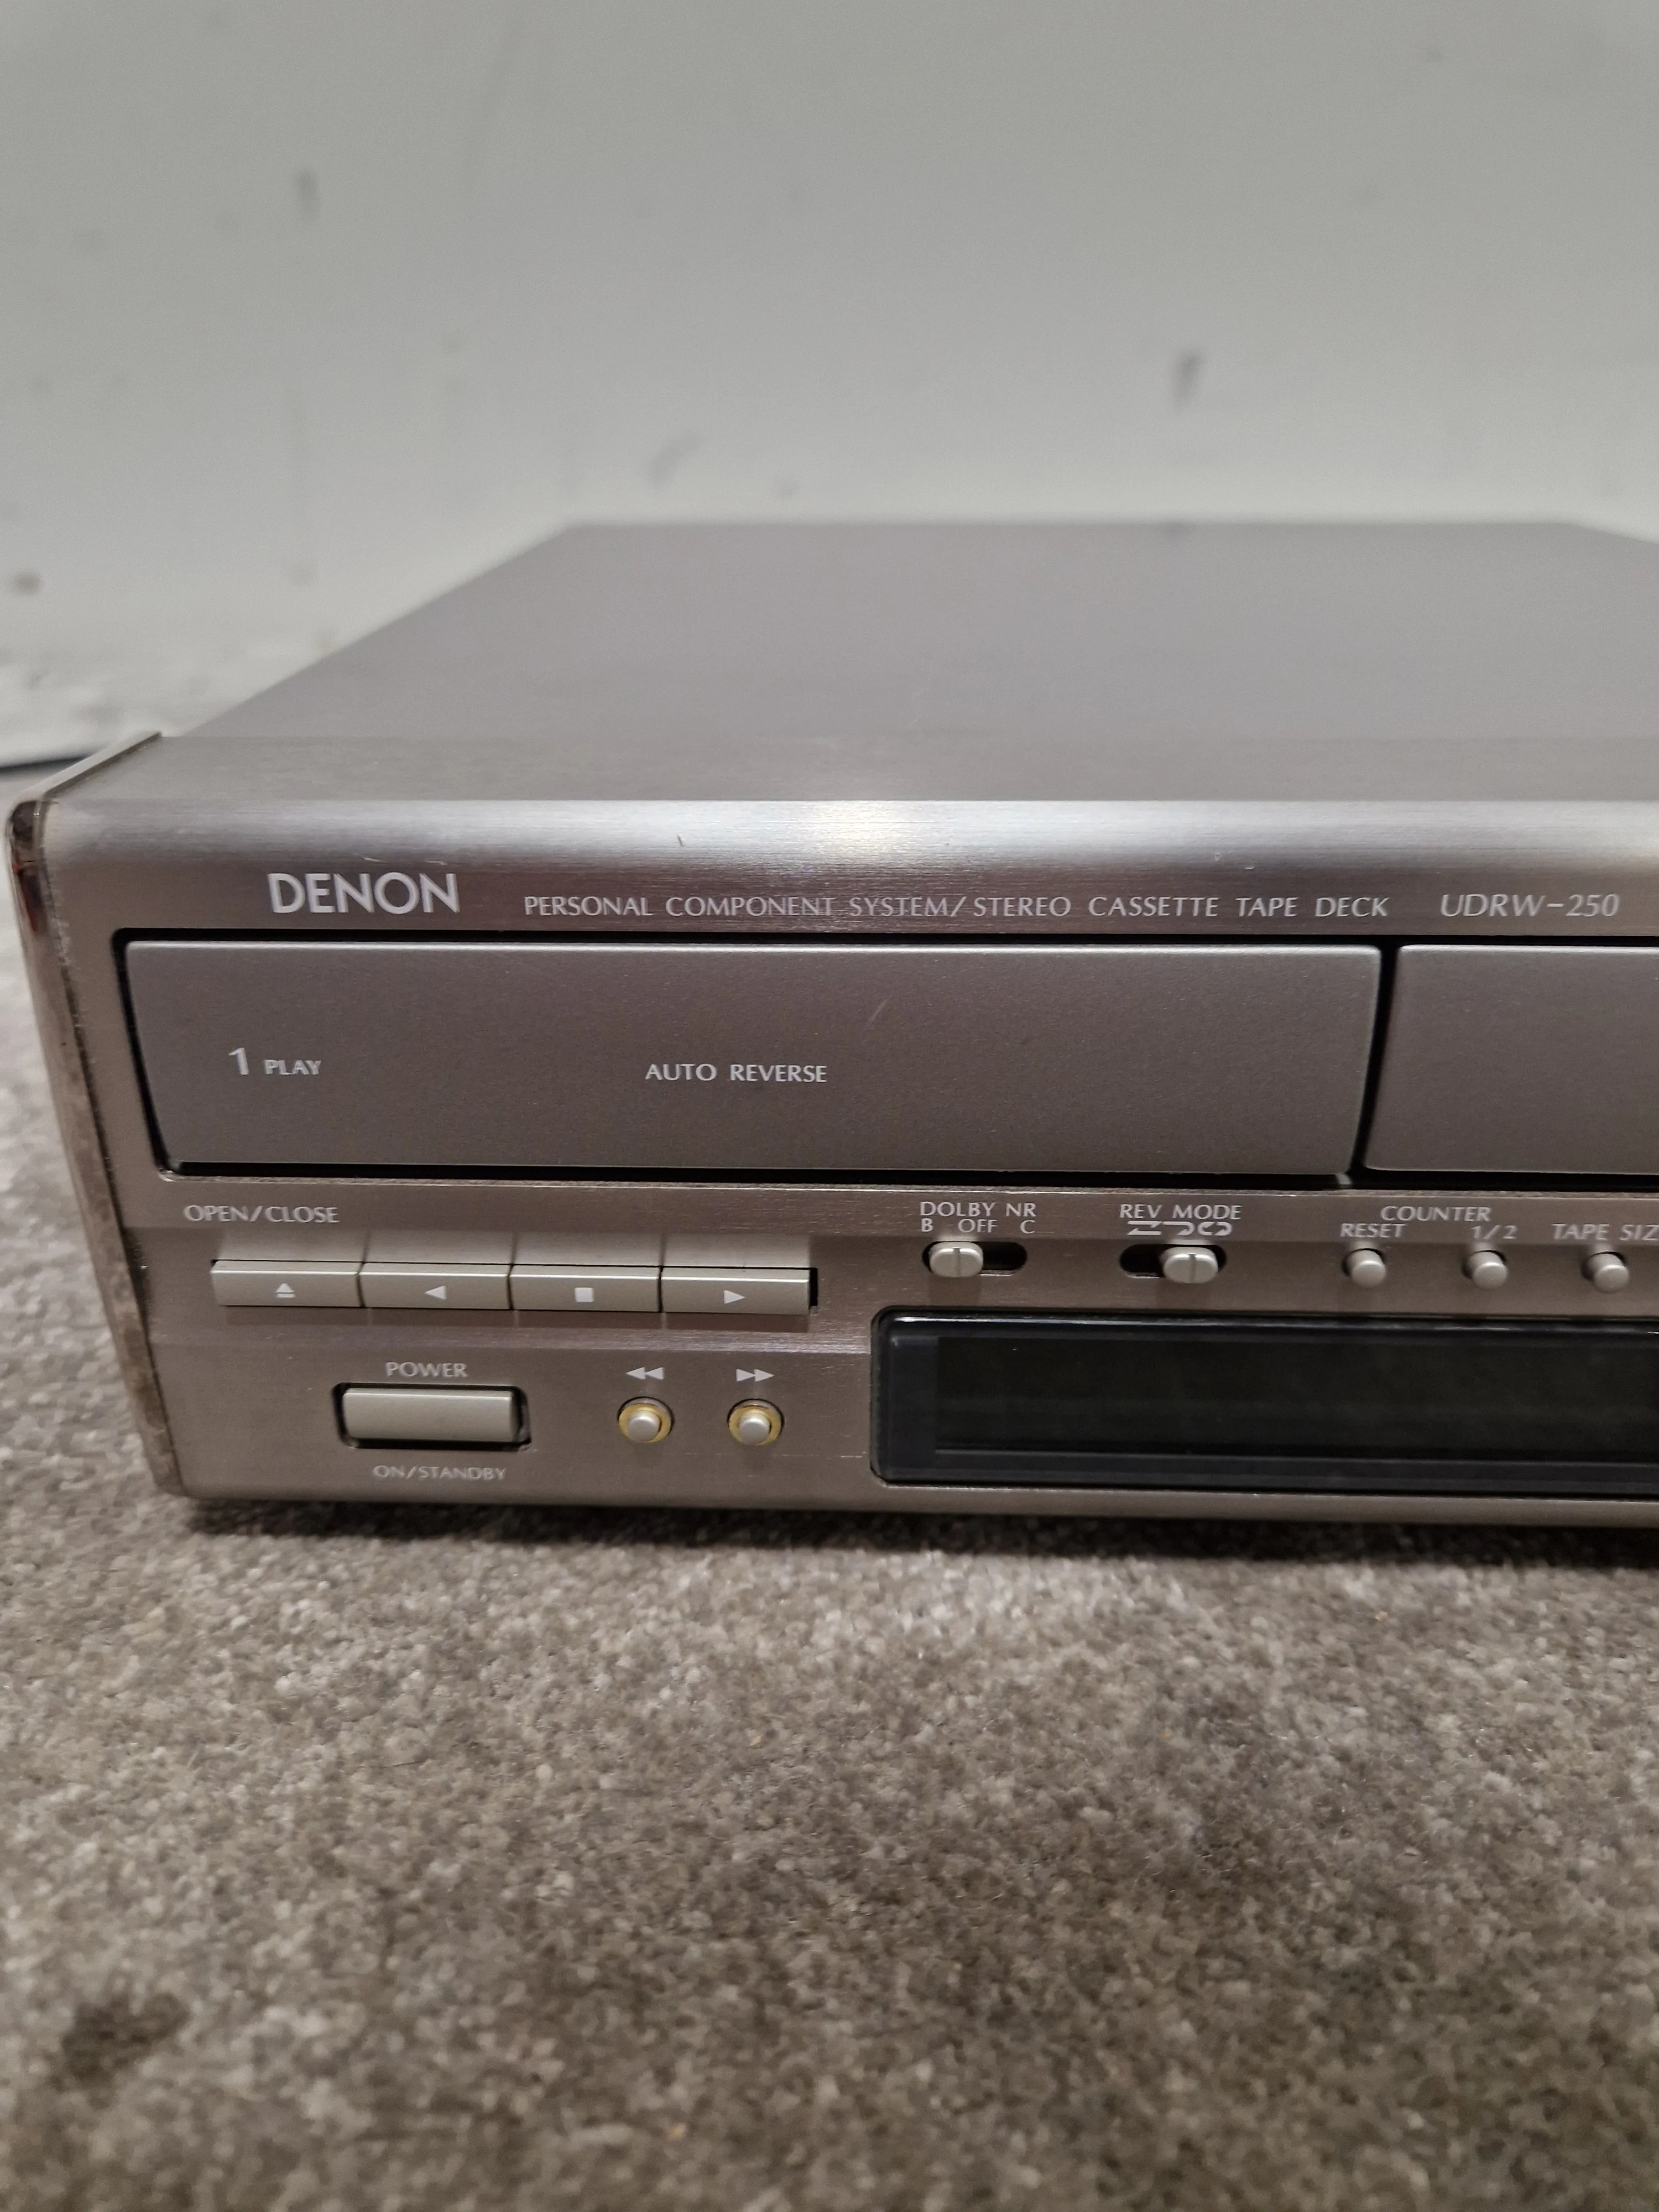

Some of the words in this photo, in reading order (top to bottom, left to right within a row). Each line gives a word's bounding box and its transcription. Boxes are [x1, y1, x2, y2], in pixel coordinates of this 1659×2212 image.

[267, 872, 461, 914] DENON
[523, 895, 654, 917] PERSONAL
[665, 896, 835, 917] COMPONENT
[1088, 895, 1220, 918] CASSETTE
[1234, 896, 1300, 917] TAPE
[1314, 896, 1390, 917] DECK
[1439, 893, 1621, 918] UDRW-250
[228, 1047, 251, 1076] 1
[263, 1058, 322, 1076] PLAY
[644, 1062, 718, 1082] AUTO
[729, 1063, 828, 1083] REVERSE
[183, 1203, 340, 1224] OPEN/CLOSE
[919, 1201, 996, 1218] DOLBY
[1005, 1202, 1037, 1218] NR
[1119, 1203, 1163, 1219] REV
[1172, 1204, 1243, 1220] MODE
[1380, 1206, 1493, 1223] COUNTER
[920, 1218, 934, 1233] B
[957, 1218, 998, 1234] OFF
[1019, 1219, 1036, 1235] C
[1339, 1223, 1407, 1239] RESET
[1551, 1223, 1610, 1241] TAPE
[385, 1361, 468, 1380] POWER
[372, 1464, 507, 1482] ON/STANDBY
